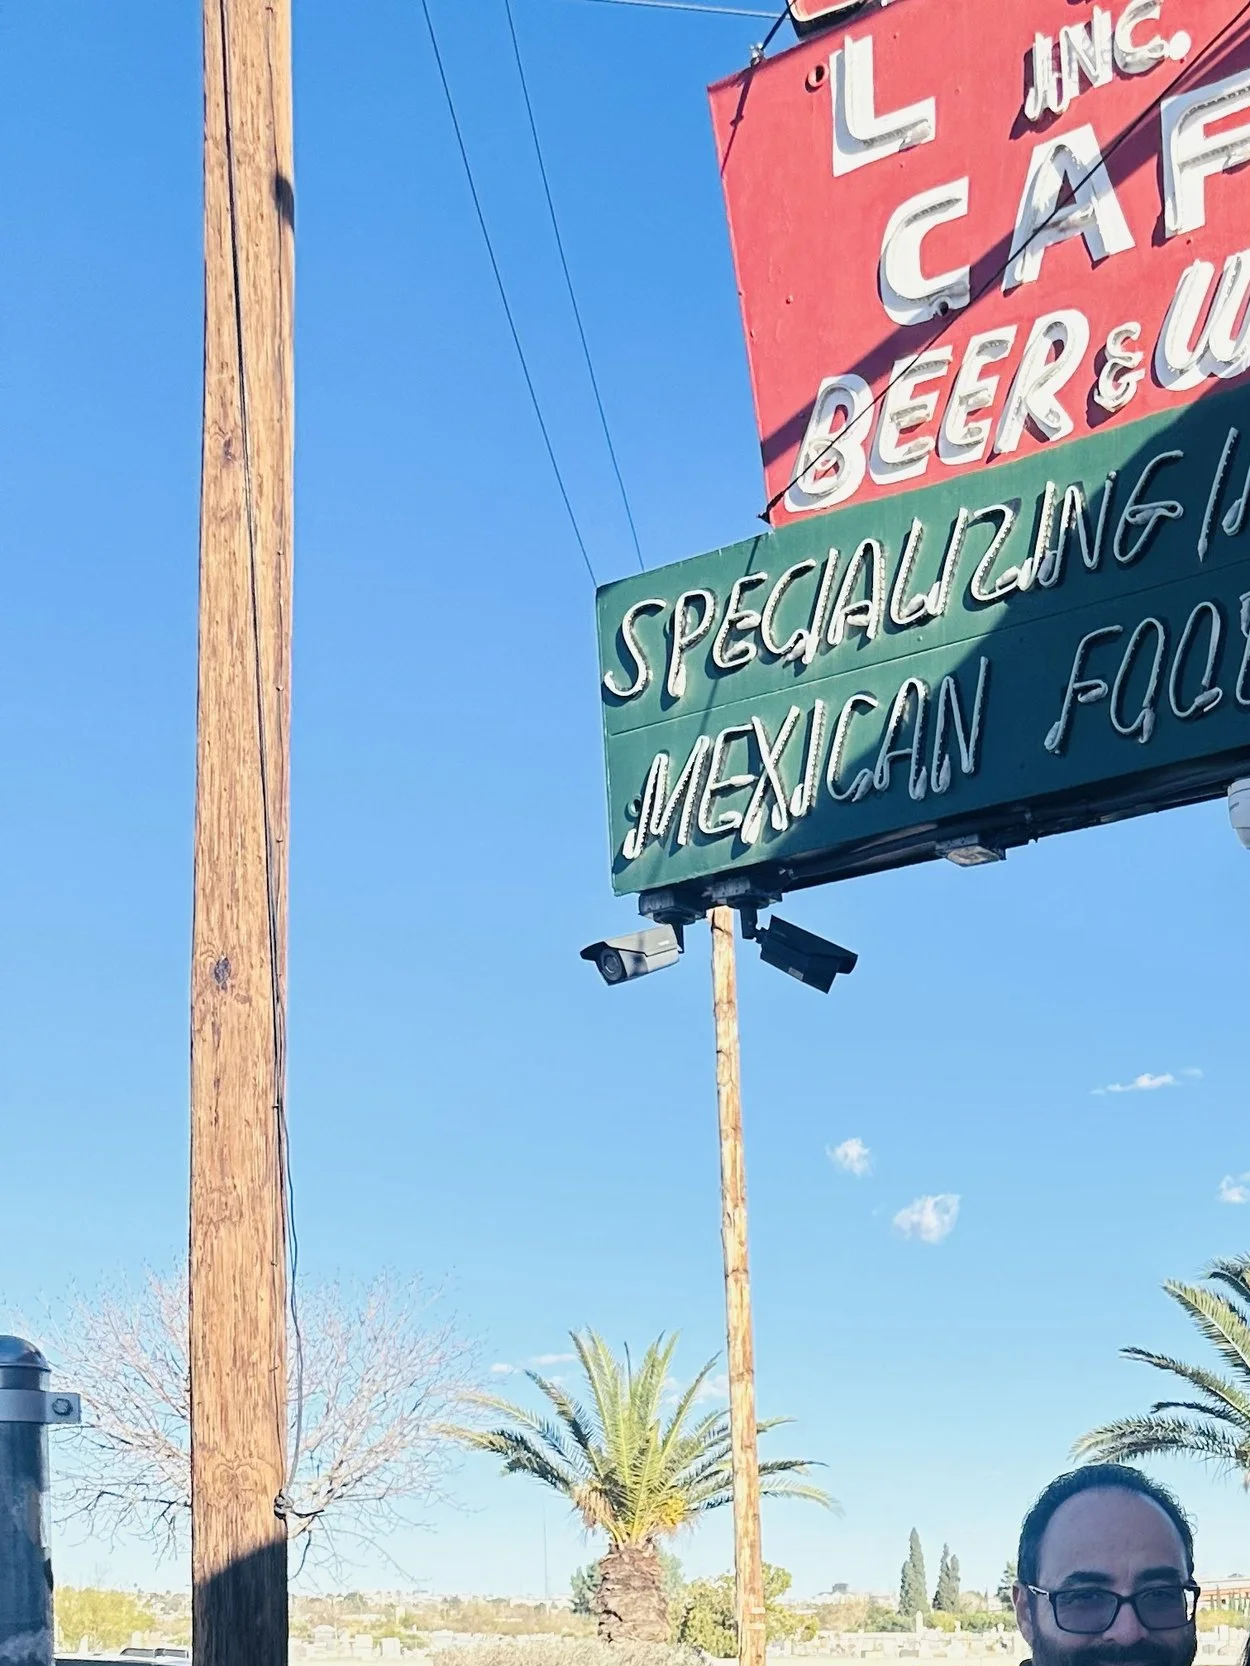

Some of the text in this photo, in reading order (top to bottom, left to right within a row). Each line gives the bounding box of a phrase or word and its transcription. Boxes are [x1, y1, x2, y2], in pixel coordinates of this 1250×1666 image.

[829, 0, 1192, 178] L INC.
[784, 308, 1091, 513] BEER
[1094, 321, 1146, 412] &
[603, 449, 1185, 698] SPECIALIZING
[622, 656, 989, 860] MEXICAN
